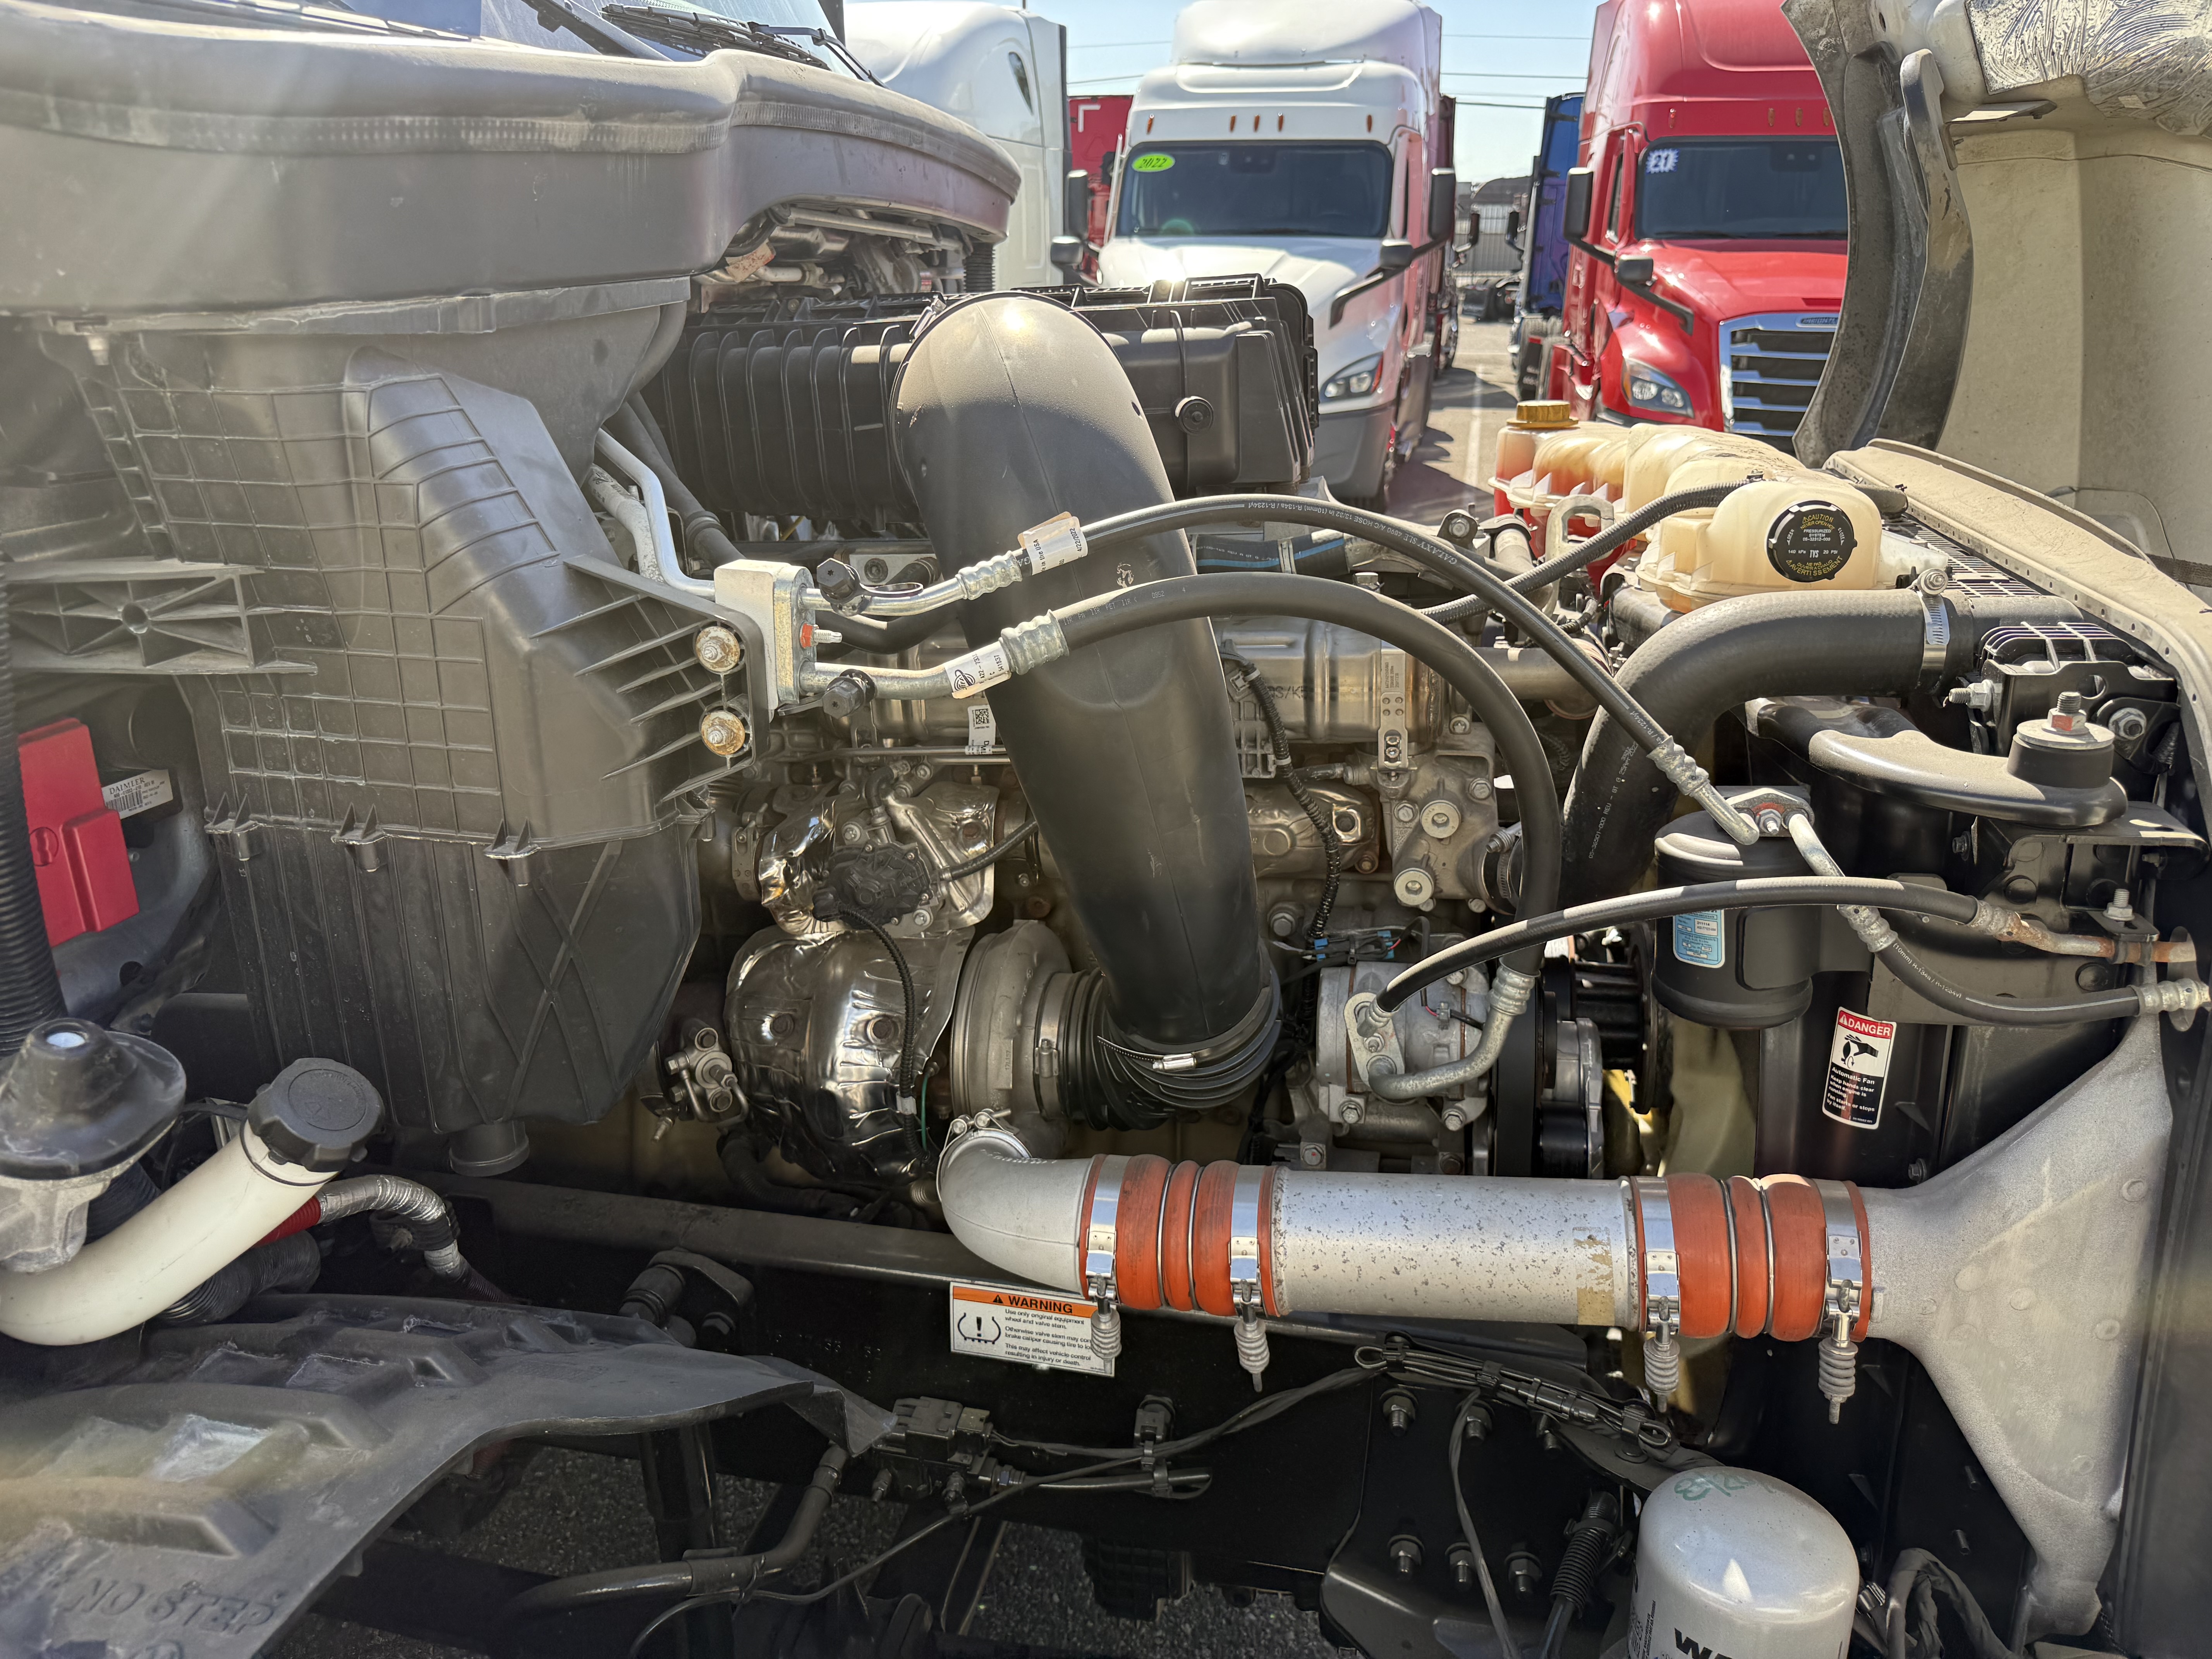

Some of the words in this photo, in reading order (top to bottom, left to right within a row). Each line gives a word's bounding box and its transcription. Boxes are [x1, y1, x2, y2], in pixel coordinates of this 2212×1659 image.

[1139, 158, 1167, 168] 2022
[1305, 506, 1327, 514] (10mm)
[1336, 512, 1352, 520] 13/32
[1354, 516, 1372, 526] HOSE
[1808, 514, 1834, 522] CAUTION
[1387, 527, 1402, 536] 4890
[1800, 521, 1815, 530] NEVER
[1070, 527, 1082, 551] 4/22/2022
[1403, 534, 1417, 544] SLE
[1417, 541, 1457, 564] GALAXY
[1790, 556, 1843, 576] AVERTISSEMENT
[1630, 711, 1654, 735] R-1234yf
[110, 777, 145, 795] DAIMLER
[1893, 943, 1912, 964] (10mm)
[1848, 1018, 1891, 1036] DANGER
[1832, 1067, 1861, 1082] Automatic
[1830, 1081, 1841, 1089] when
[1842, 1087, 1860, 1095] engine
[1831, 1075, 1842, 1084] Keep
[1843, 1080, 1858, 1089] hands
[1009, 1295, 1072, 1313] WARNING
[1005, 1326, 1034, 1334] Otherwise
[146, 1585, 276, 1635] STEP
